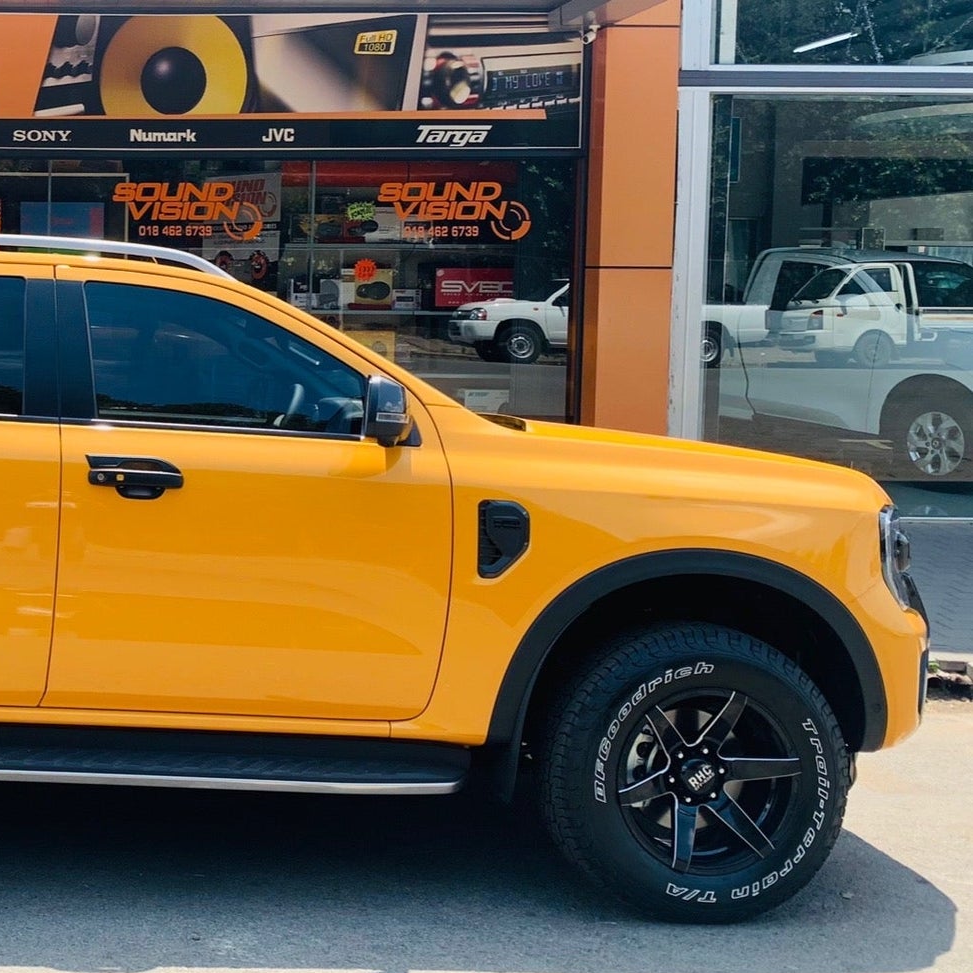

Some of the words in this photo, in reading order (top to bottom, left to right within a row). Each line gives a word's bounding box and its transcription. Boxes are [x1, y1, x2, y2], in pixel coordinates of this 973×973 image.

[364, 43, 386, 51] 1080
[13, 130, 70, 142] SONY
[130, 128, 196, 143] Numark
[262, 128, 295, 143] JVC
[416, 125, 493, 147] Targa
[112, 181, 235, 202] SOUND
[377, 181, 502, 202] SOUND
[127, 201, 240, 221] VISION
[393, 200, 508, 221] VISION
[138, 225, 159, 236] 018
[162, 225, 183, 236] 462
[185, 225, 213, 236] 6739
[427, 225, 448, 237] 462
[451, 226, 479, 237] 6739
[688, 765, 712, 788] RHC
